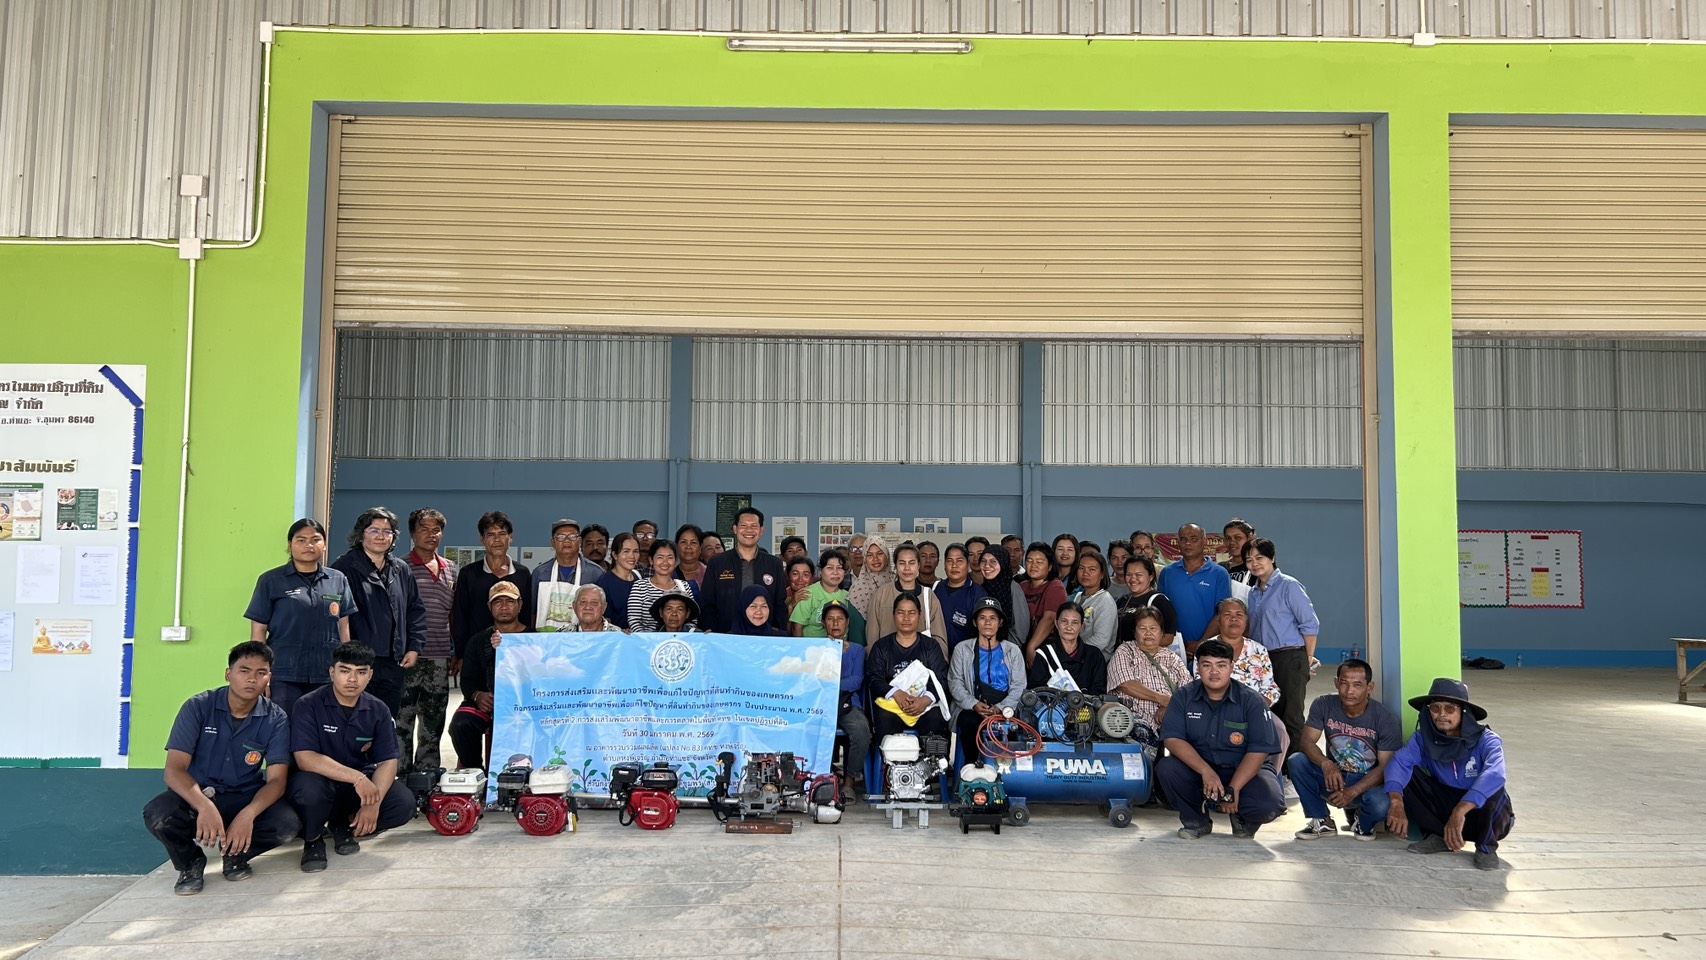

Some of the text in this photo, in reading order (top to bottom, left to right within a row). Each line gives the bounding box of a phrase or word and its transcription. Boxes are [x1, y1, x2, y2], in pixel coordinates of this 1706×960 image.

[68, 416, 95, 424] 86140
[806, 707, 824, 715] 2569
[1046, 758, 1107, 775] PUMA
